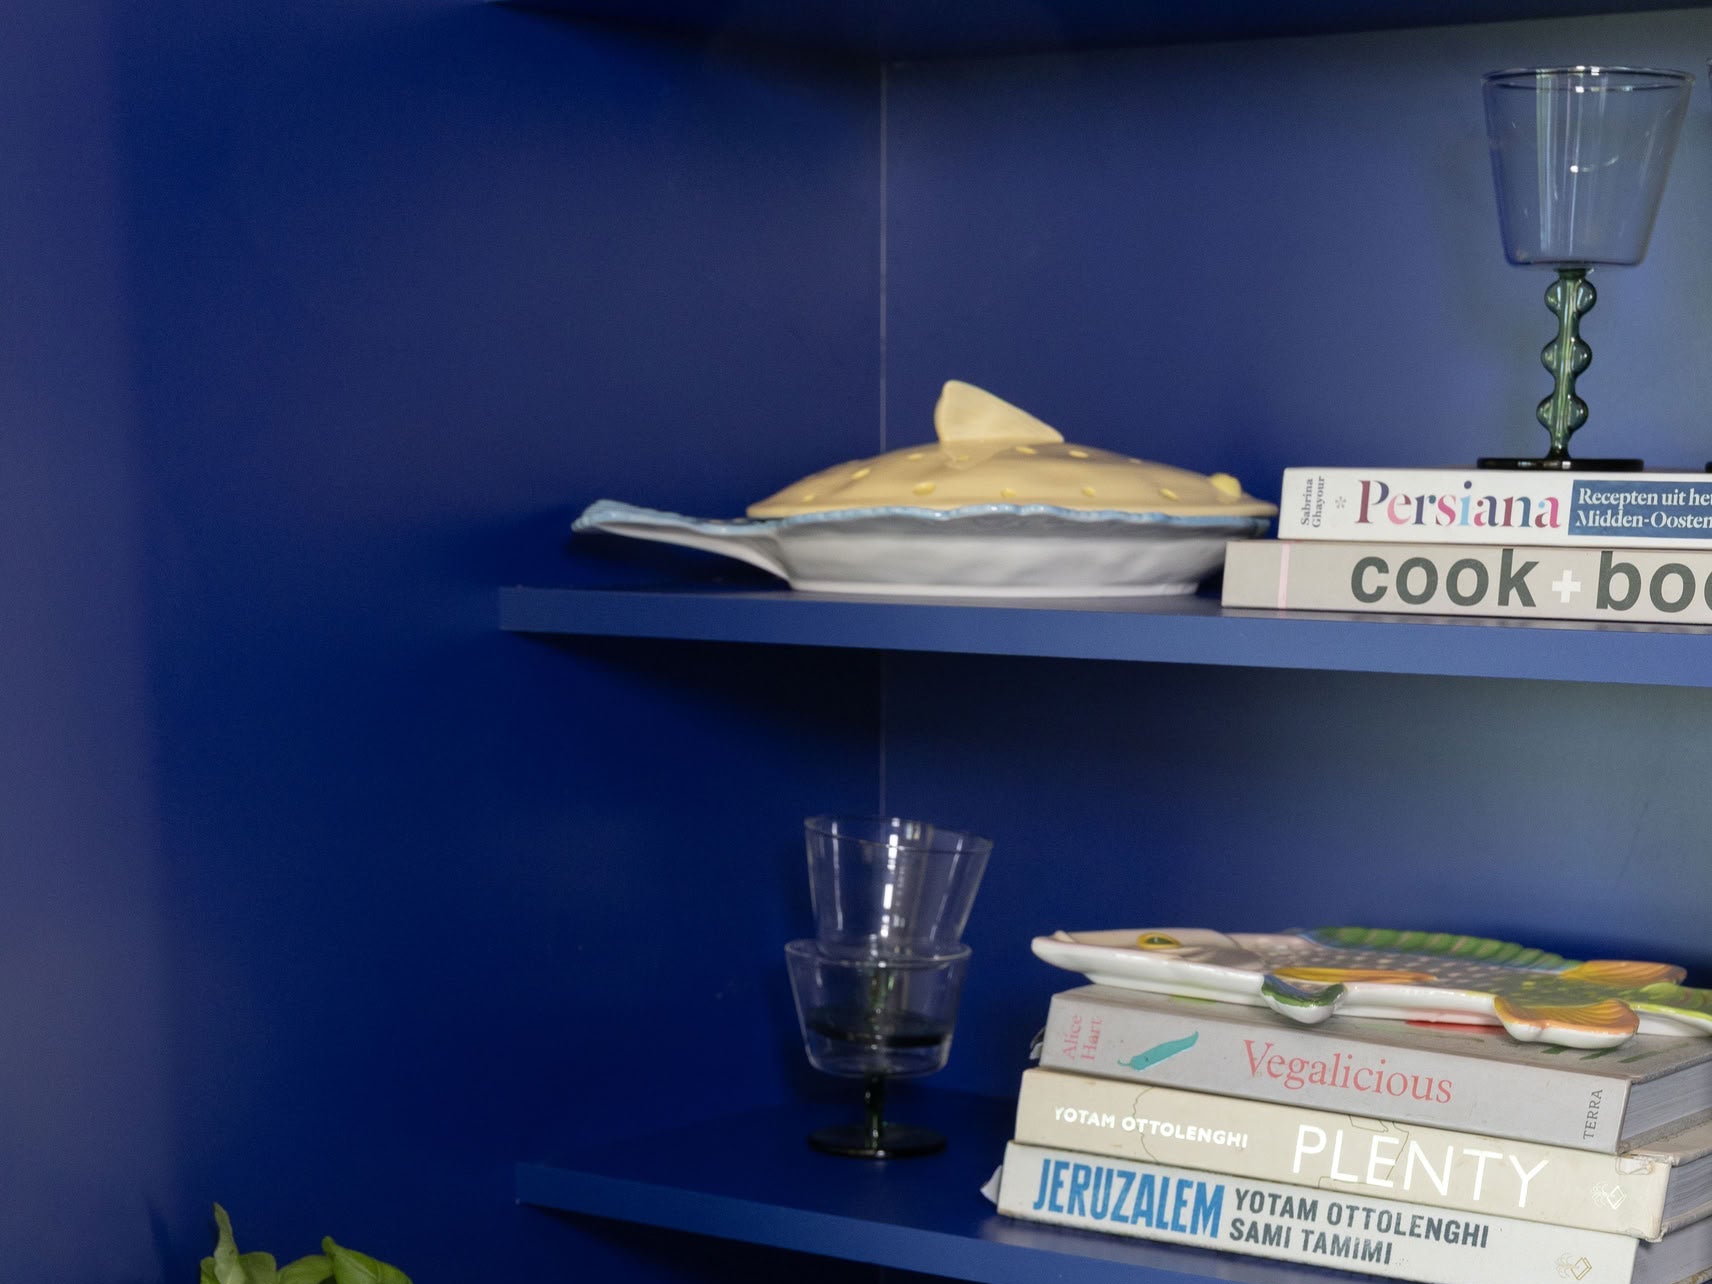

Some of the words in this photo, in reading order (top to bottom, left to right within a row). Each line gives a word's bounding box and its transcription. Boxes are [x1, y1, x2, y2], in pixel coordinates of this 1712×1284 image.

[1301, 478, 1313, 526] Sabrina
[1312, 476, 1325, 528] Ghayour
[1354, 480, 1561, 528] Persiana
[1578, 488, 1658, 510] Recepten
[1662, 489, 1686, 506] uit
[1351, 548, 1540, 608] cook
[1596, 551, 1712, 613] bo
[1062, 1015, 1082, 1060] Alice
[1081, 1016, 1104, 1060] Hart
[1243, 1039, 1453, 1104] Vegalicious
[1055, 1106, 1116, 1129] YOTAM
[1121, 1116, 1249, 1149] OTTOLENGHI
[1583, 1089, 1603, 1140] TERRA
[1292, 1124, 1549, 1208] PLENTY
[1033, 1158, 1226, 1239] JERUZALEM
[1235, 1188, 1319, 1223] YOTAM
[1326, 1201, 1490, 1249] OTTOLENGHI
[1229, 1218, 1292, 1249] SAMI
[1301, 1228, 1393, 1265] TAMIMI
